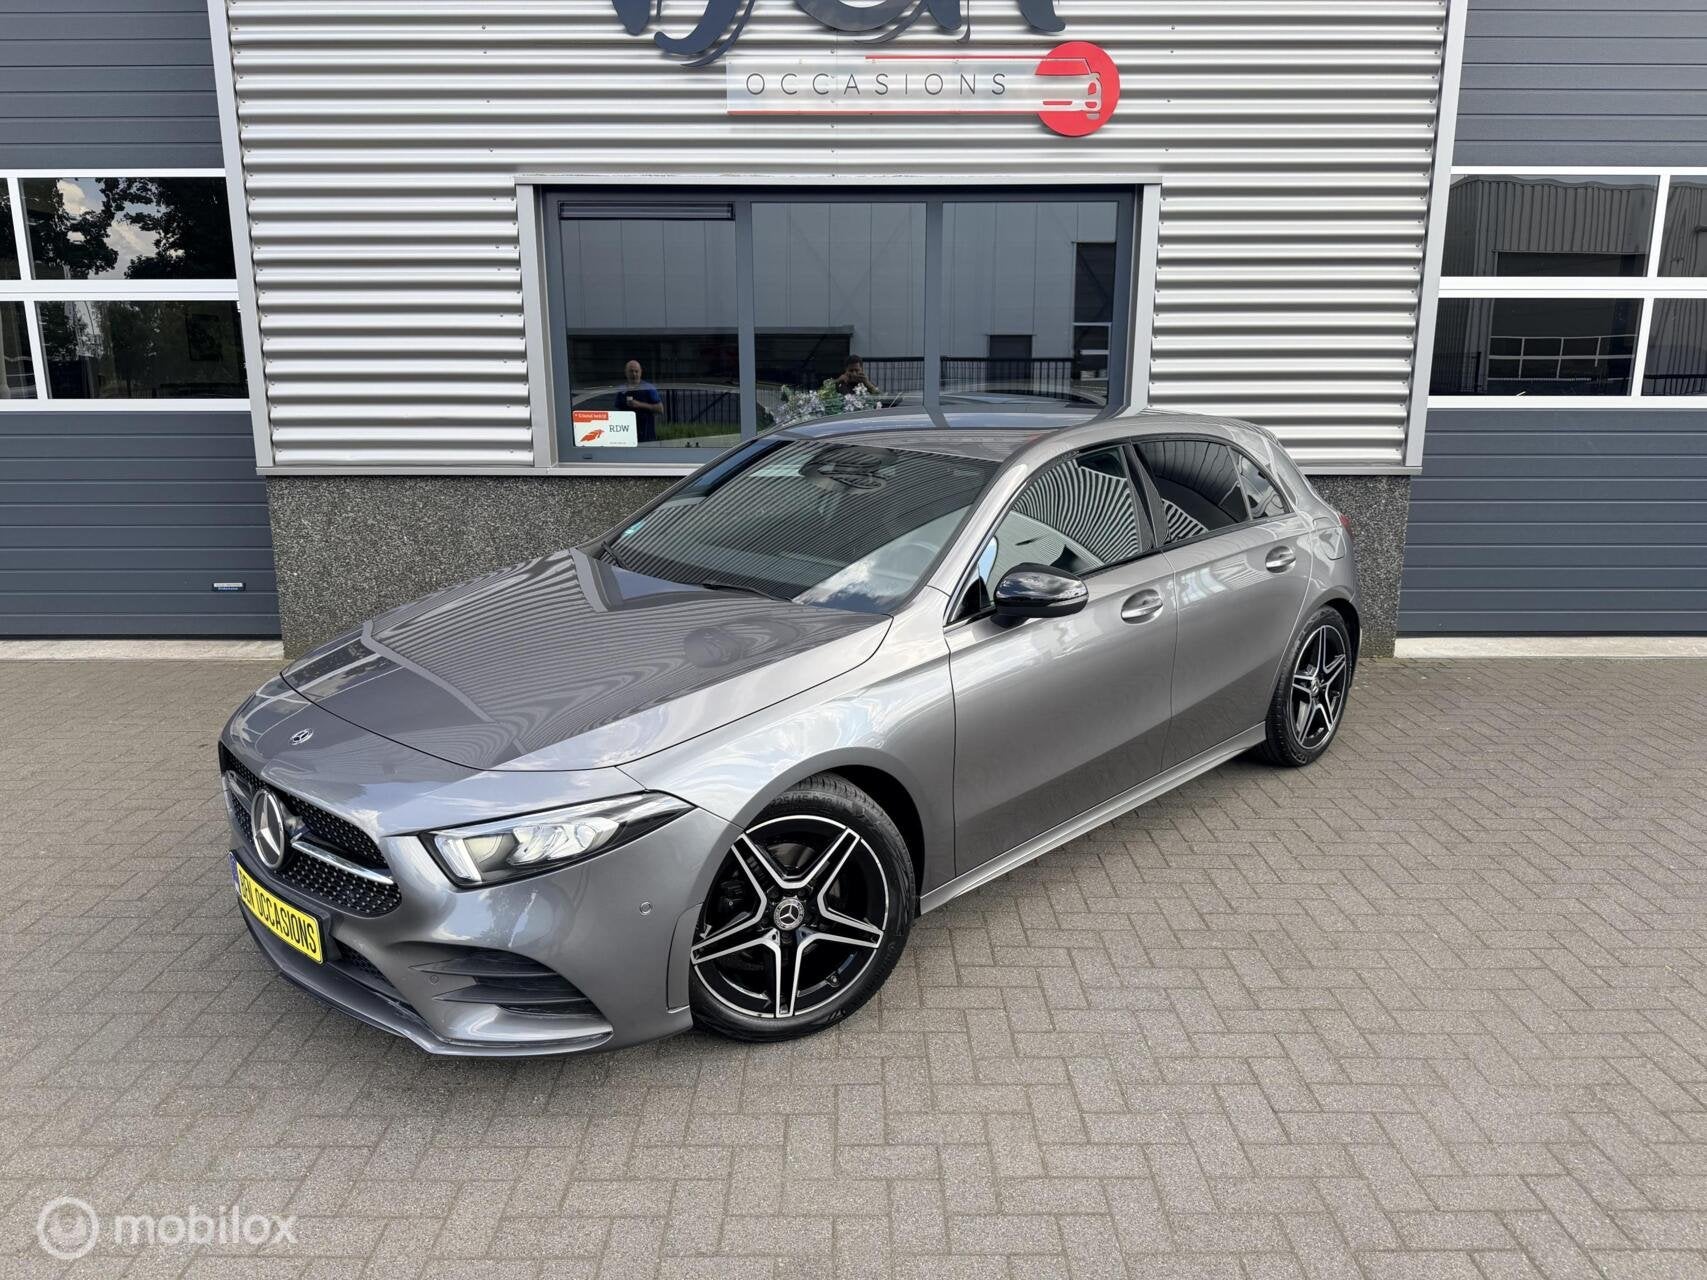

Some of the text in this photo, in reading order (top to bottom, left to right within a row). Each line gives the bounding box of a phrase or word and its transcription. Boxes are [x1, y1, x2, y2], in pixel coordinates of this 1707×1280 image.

[745, 72, 1007, 96] OCCASIONS
[609, 424, 630, 433] RDW
[254, 887, 317, 954] OCCASIONS
